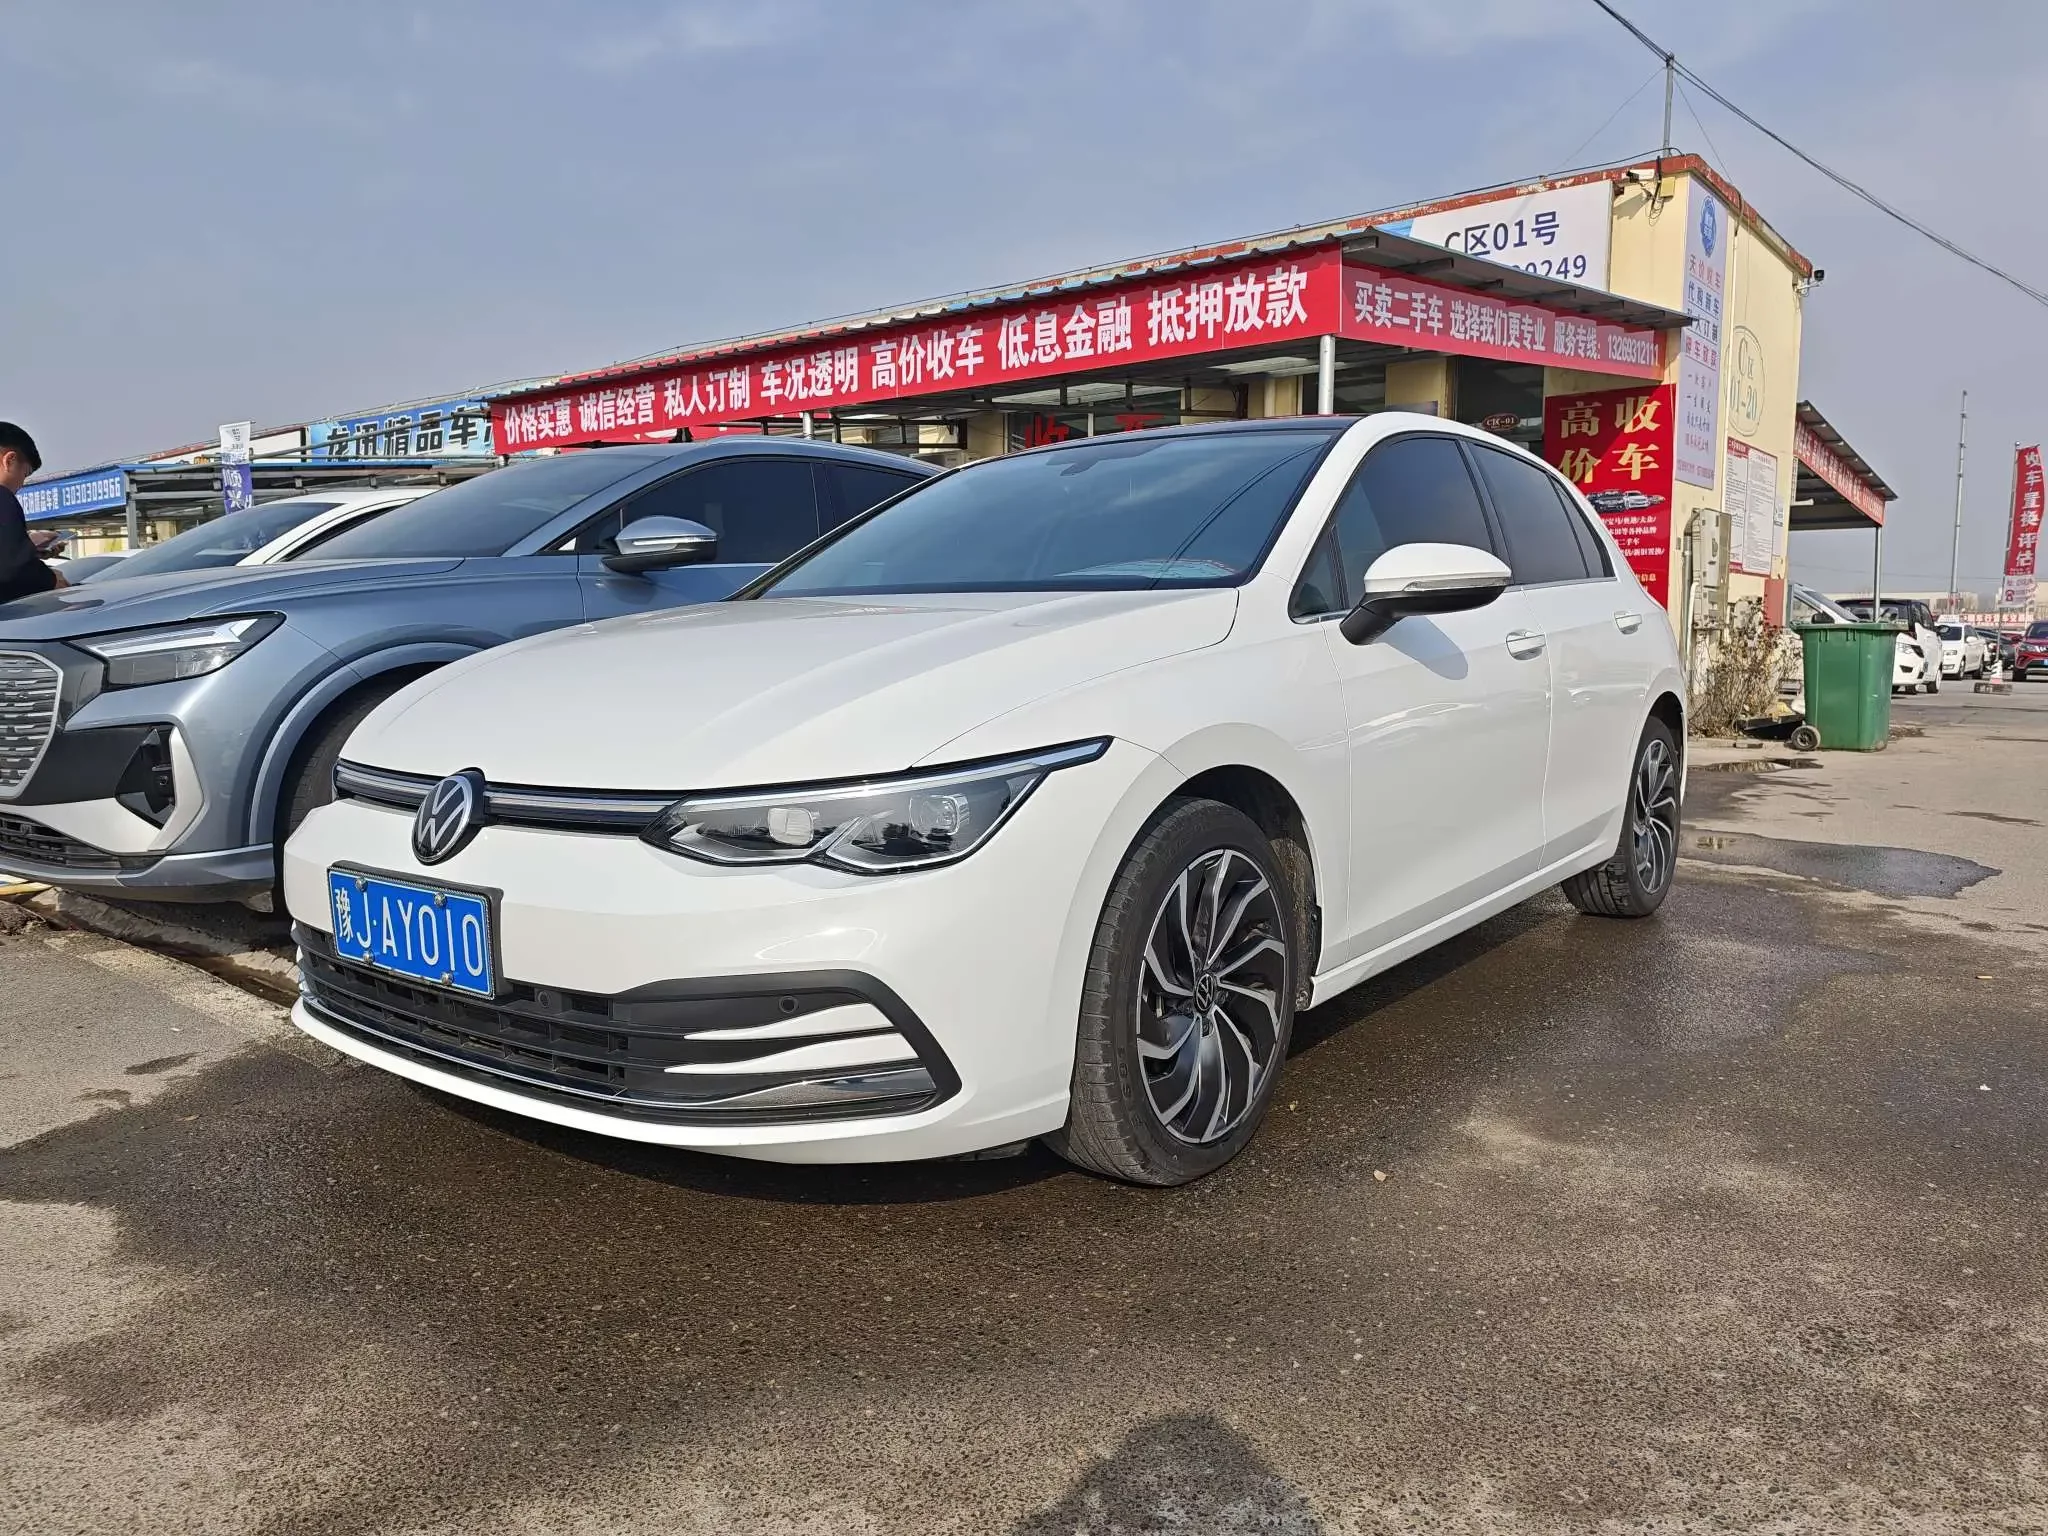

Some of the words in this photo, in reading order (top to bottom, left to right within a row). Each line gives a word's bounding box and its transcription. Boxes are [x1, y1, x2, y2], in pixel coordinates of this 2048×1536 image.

[1354, 280, 1444, 337] 买卖二手车
[1449, 300, 1547, 352] 选择我们更专业
[504, 398, 573, 444] 价格实惠
[578, 382, 656, 433] 诚信经营
[664, 364, 751, 420] 私人订制
[760, 347, 859, 405] 车况透明
[871, 325, 985, 390] 高价收车
[997, 294, 1133, 371] 低息金融
[1147, 265, 1309, 347] 抵押放款
[327, 404, 494, 462] 龙讯精品车
